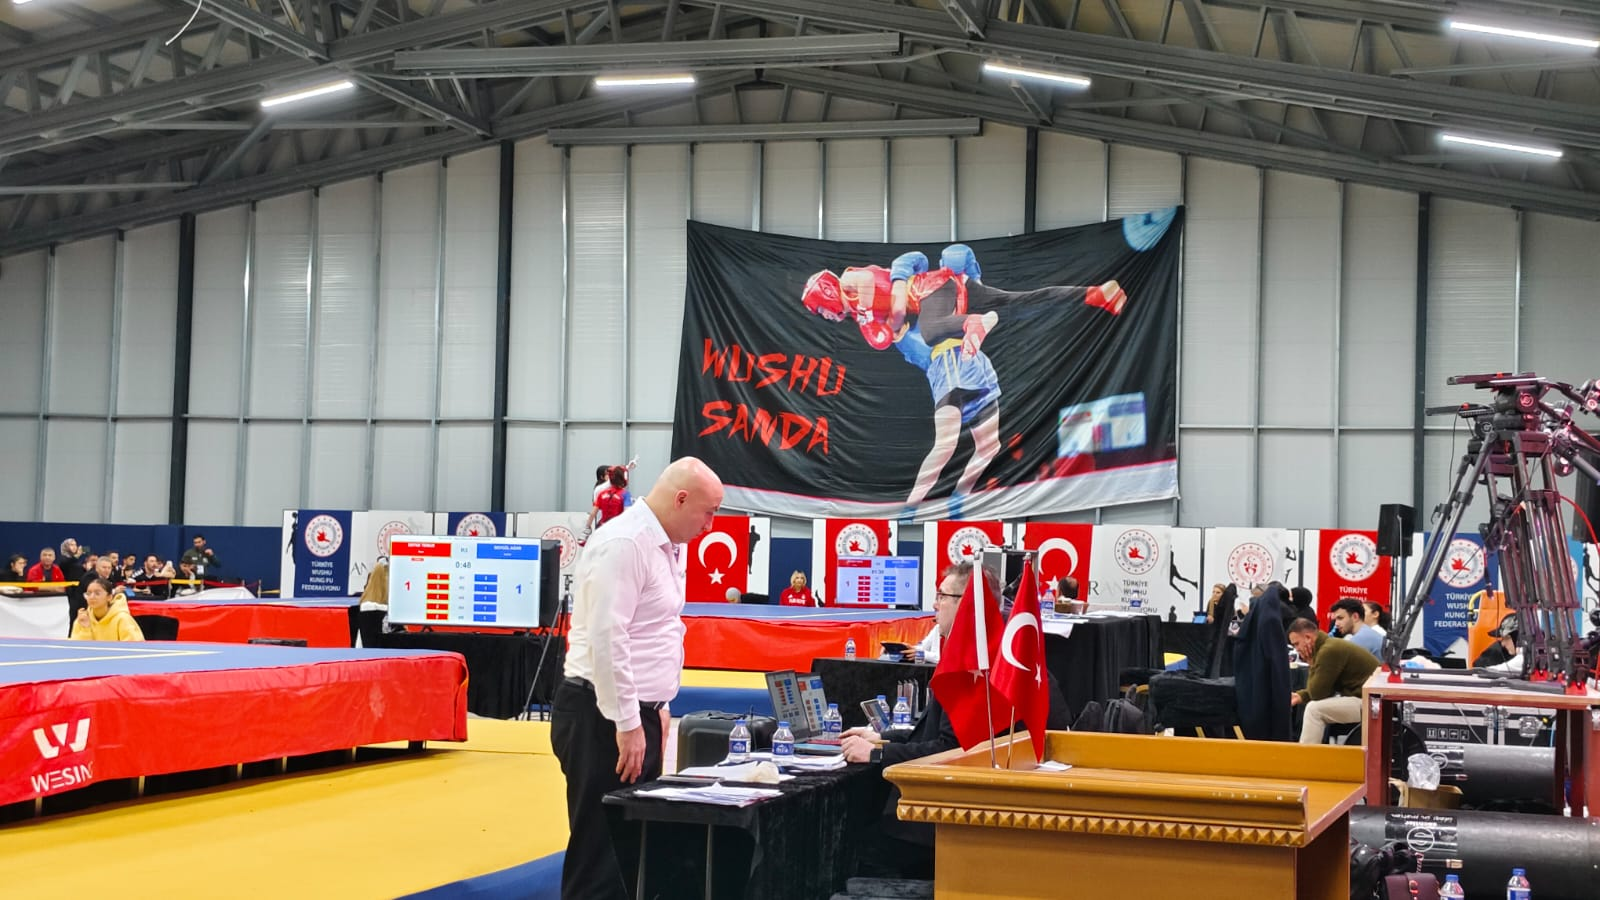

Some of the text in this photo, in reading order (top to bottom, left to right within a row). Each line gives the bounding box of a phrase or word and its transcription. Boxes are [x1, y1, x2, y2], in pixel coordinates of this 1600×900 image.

[702, 338, 846, 396] WUSHU
[698, 400, 830, 456] SANDA
[301, 584, 340, 592] FEDERASYONU
[404, 581, 411, 591] 1
[1123, 579, 1148, 588] TÜRKİYE
[515, 584, 522, 594] 1
[1123, 588, 1148, 596] WUHU
[1339, 585, 1368, 594] TÜRKİYE
[1444, 611, 1466, 619] KUNG
